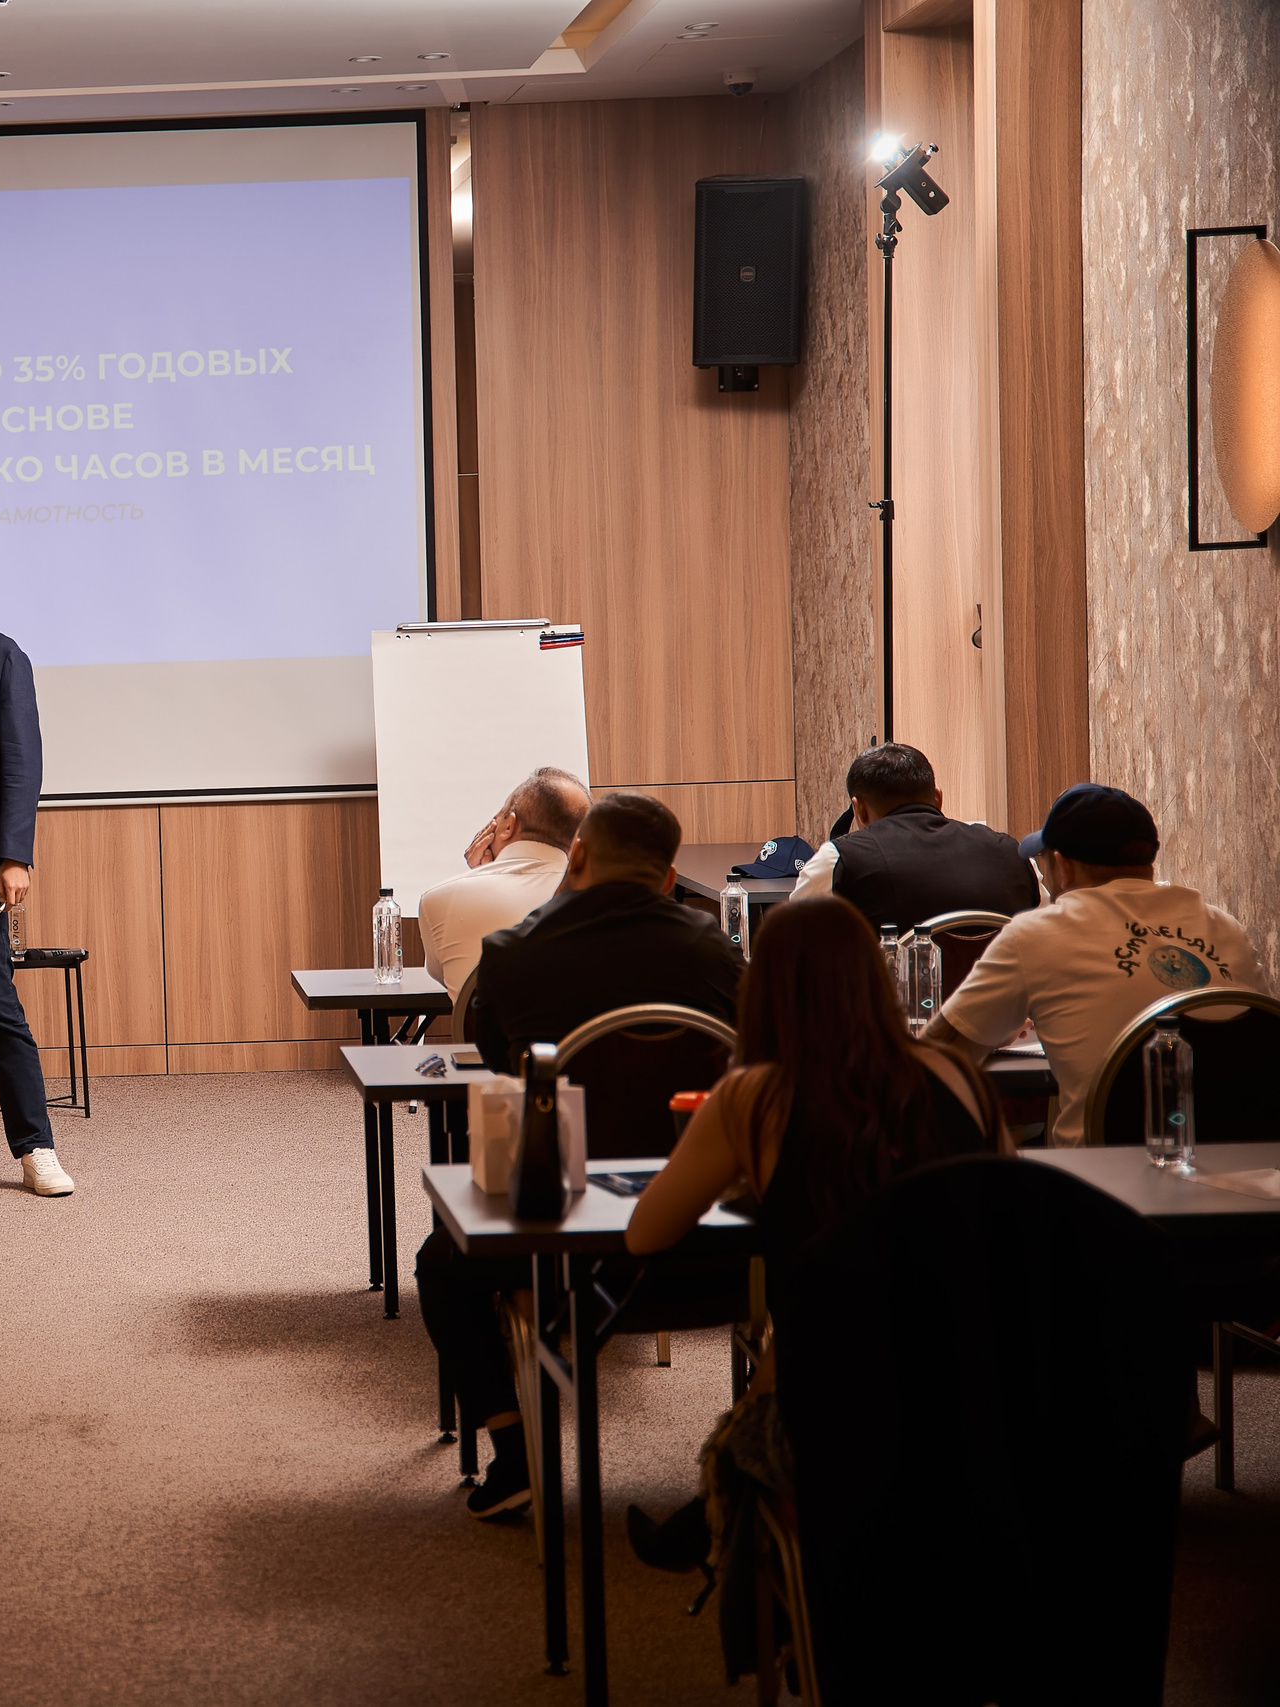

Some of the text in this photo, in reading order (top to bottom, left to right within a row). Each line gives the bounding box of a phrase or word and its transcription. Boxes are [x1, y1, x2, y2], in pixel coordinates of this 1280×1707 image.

[13, 355, 86, 383] 35%
[99, 348, 294, 383] ГОДОВЫХ
[55, 451, 189, 481] ЧАСОВ
[203, 450, 225, 476] В
[239, 444, 375, 475] МЕСЯЦ
